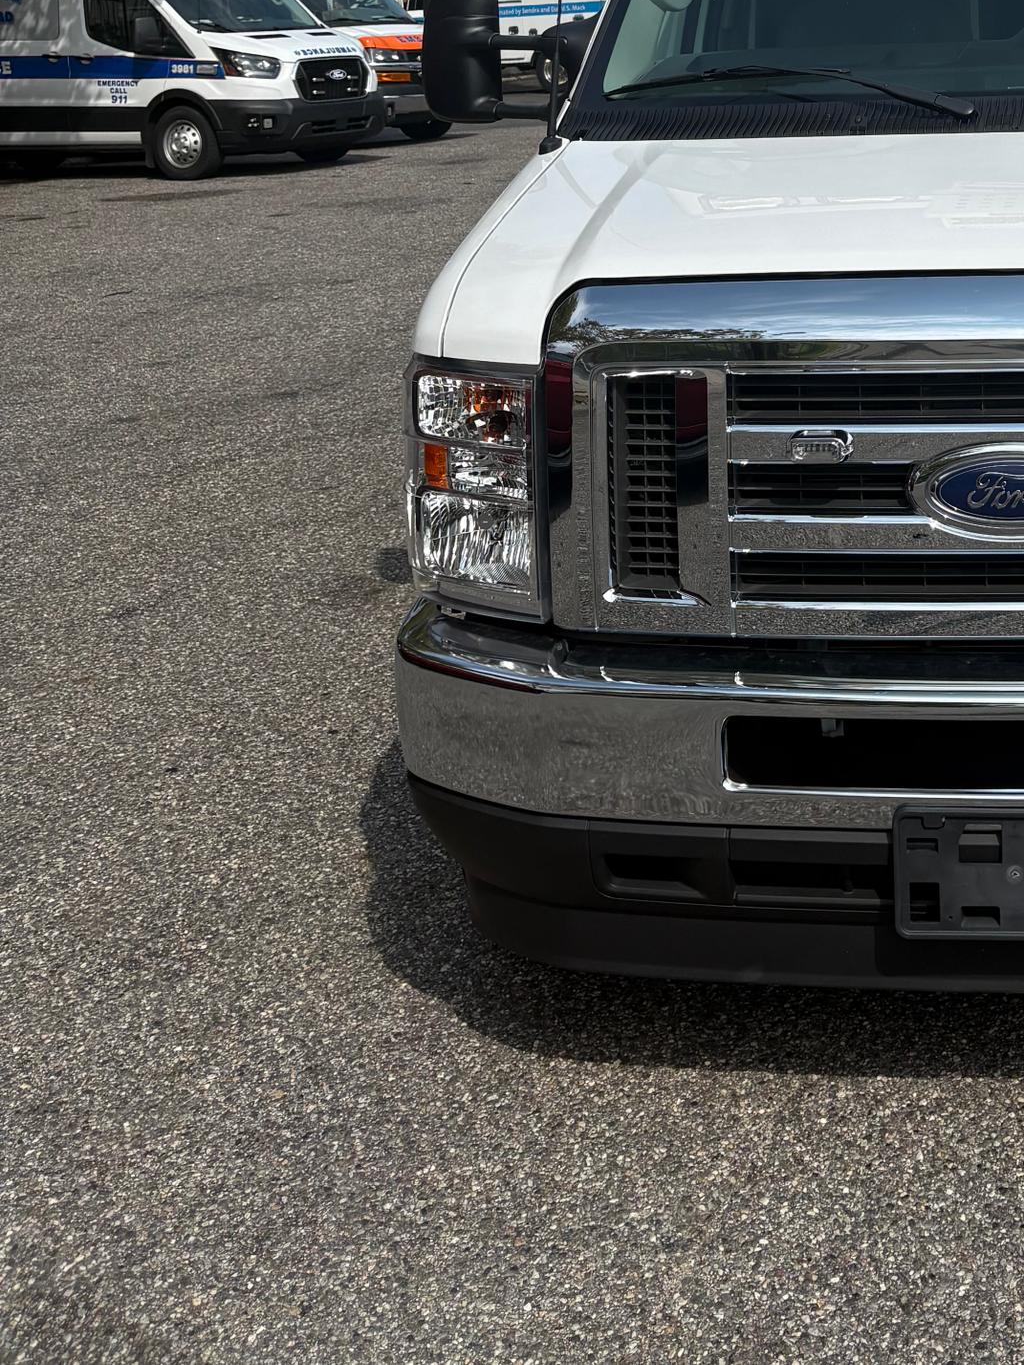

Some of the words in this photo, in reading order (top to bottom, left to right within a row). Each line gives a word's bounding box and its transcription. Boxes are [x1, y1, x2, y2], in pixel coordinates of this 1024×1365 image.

[515, 8, 521, 16] by
[171, 64, 194, 74] 3981
[111, 95, 127, 104] 911
